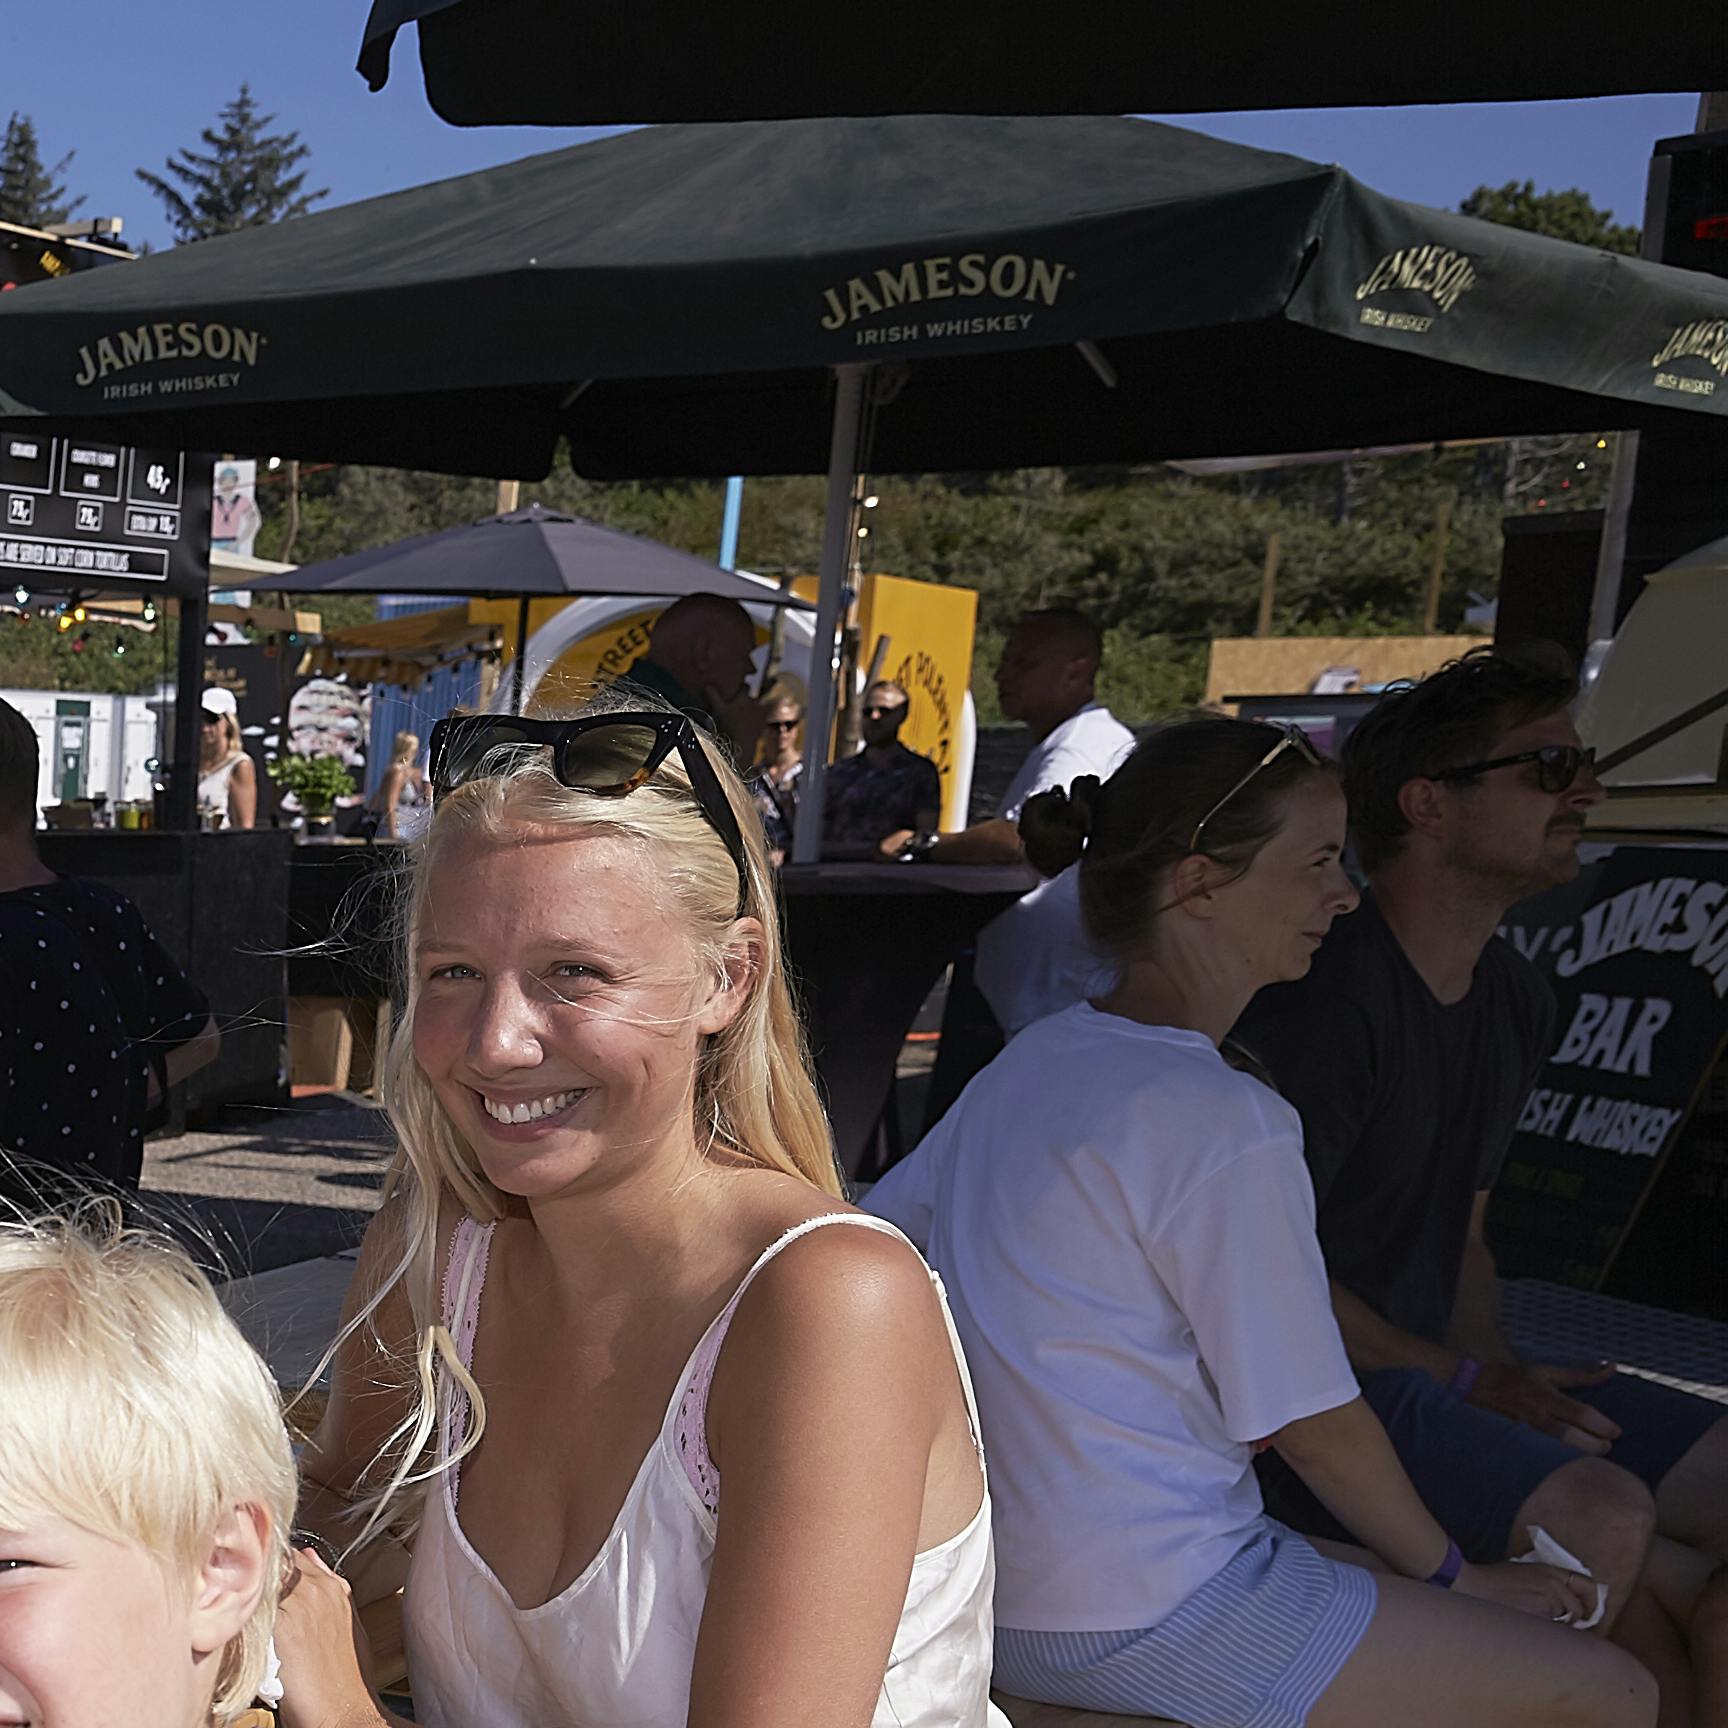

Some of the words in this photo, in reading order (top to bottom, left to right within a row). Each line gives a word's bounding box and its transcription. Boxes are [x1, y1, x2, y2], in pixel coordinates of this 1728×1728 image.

[821, 254, 1066, 331] JAMESON
[1355, 244, 1476, 313] JAMESON
[75, 322, 259, 387] JAMESON
[856, 325, 919, 345] IRISH
[926, 314, 1033, 338] WHISKEY
[104, 383, 152, 400] IRISH
[159, 372, 241, 393] WHISKEY
[1550, 993, 1672, 1079] BAR
[1566, 1093, 1683, 1160] WHISKEY
